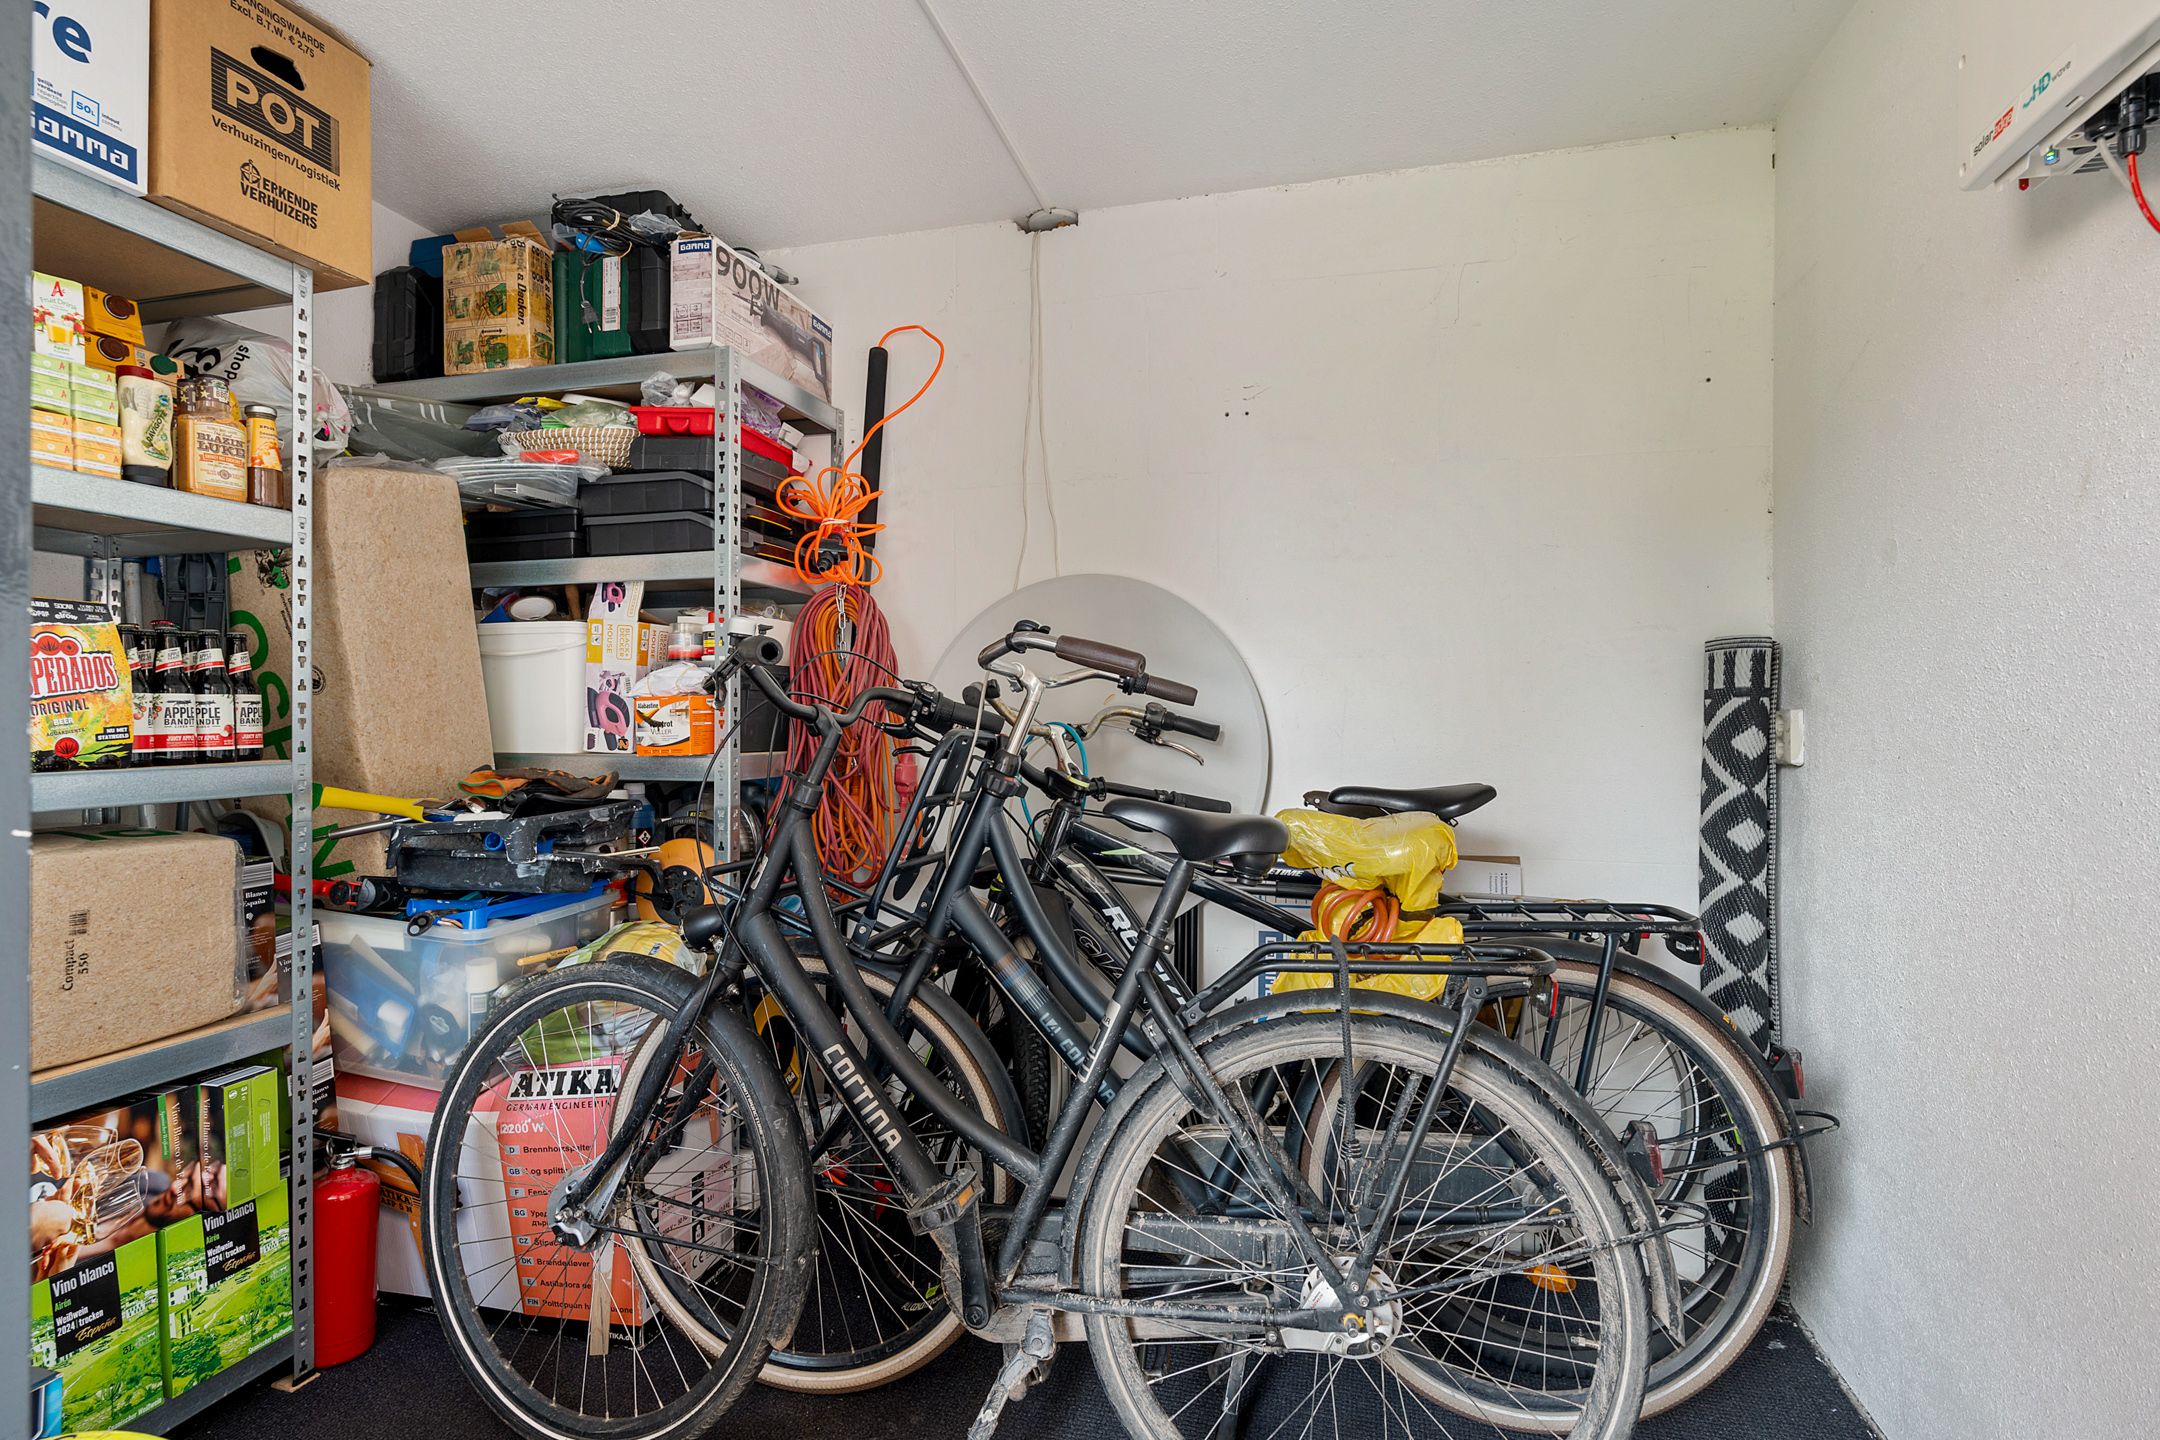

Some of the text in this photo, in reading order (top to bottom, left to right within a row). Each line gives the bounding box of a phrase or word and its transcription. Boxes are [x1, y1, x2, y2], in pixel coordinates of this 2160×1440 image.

[230, 0, 254, 20] Excl.
[297, 40, 316, 58] 2,75
[226, 67, 320, 150] POT
[211, 114, 341, 191] Verhuizingen/Logistiek
[240, 181, 318, 230] VERHUIZERS
[262, 177, 319, 216] ERKENDE
[715, 245, 780, 311] 900W
[517, 283, 527, 326] Decker
[31, 654, 116, 695] PERADOS
[195, 706, 221, 719] PPLE
[1268, 868, 1305, 877] ETIME
[245, 890, 268, 899] Blanco
[63, 938, 77, 991] Compact
[78, 953, 89, 974] 550
[510, 1068, 619, 1098] ATIKA
[171, 1102, 181, 1126] Vino
[506, 1102, 546, 1112] GERMAN
[204, 1202, 255, 1232] Vino blanco
[207, 1240, 234, 1258] Weißwein
[518, 1237, 529, 1245] CZ
[207, 1244, 246, 1268] 2024 trocken
[520, 1257, 533, 1265] DK
[52, 1261, 115, 1298] Vino blanco
[56, 1305, 89, 1327] Weißwein
[527, 1298, 539, 1306] FIN
[57, 1309, 104, 1337] 2024 trocken
